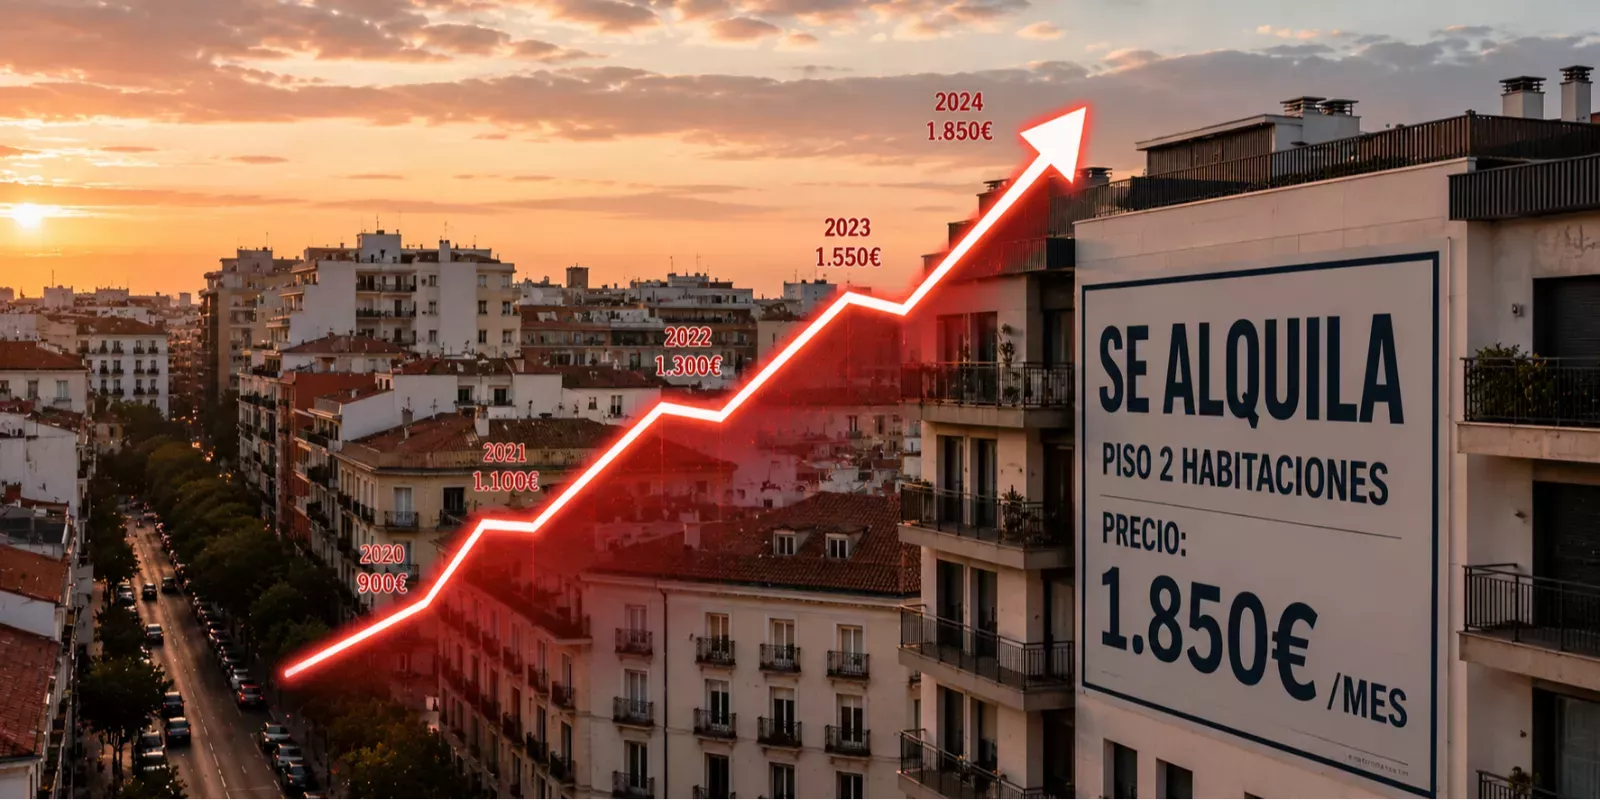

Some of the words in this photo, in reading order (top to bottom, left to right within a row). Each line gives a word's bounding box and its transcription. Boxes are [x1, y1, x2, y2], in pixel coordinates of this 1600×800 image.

[1099, 324, 1150, 414] SE
[1162, 313, 1405, 429] ALQUILA
[1102, 441, 1152, 481] PISO
[1159, 445, 1174, 483] 2
[1182, 448, 1389, 507] HABITACIONES
[1102, 511, 1188, 557] PRECIO:
[1101, 565, 1319, 702] 1.850€
[1327, 671, 1408, 729] /MES
